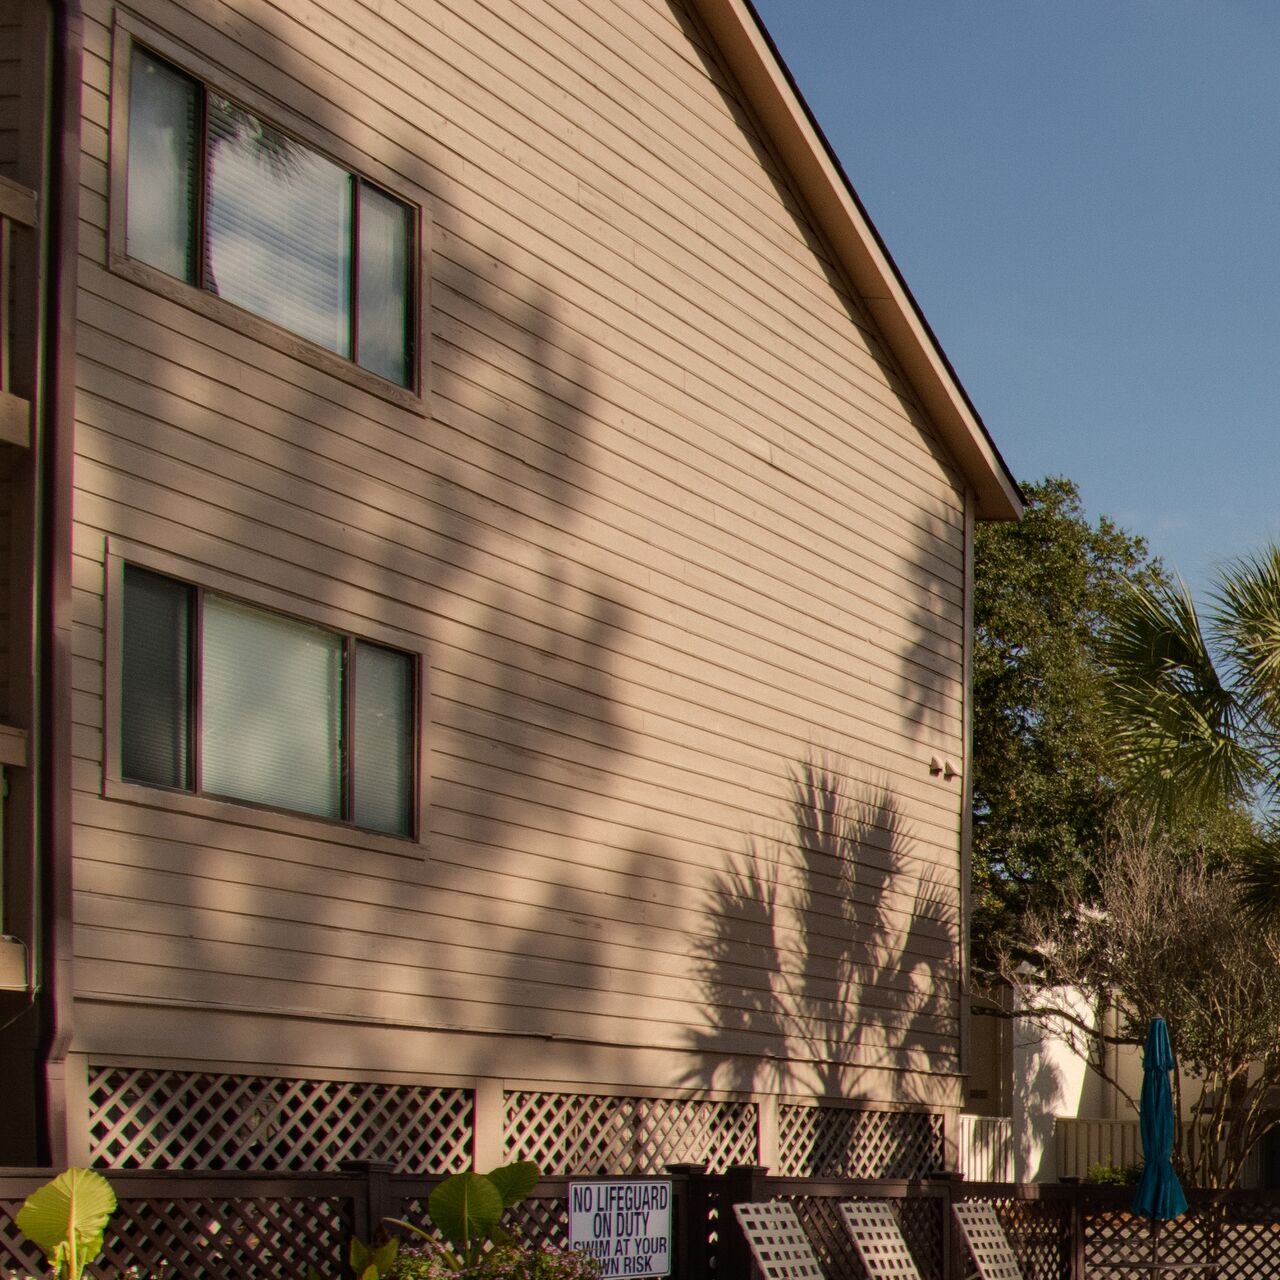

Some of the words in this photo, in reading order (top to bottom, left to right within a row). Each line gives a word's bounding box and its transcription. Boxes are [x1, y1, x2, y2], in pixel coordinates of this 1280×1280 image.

[573, 1186, 592, 1213] NO
[597, 1185, 668, 1212] LIFEGUARD
[593, 1213, 612, 1238] ON
[616, 1211, 650, 1237] DUTY
[615, 1239, 631, 1257] AT
[634, 1236, 667, 1255] YOUR
[599, 1257, 619, 1275] WN
[624, 1255, 653, 1273] RISK
